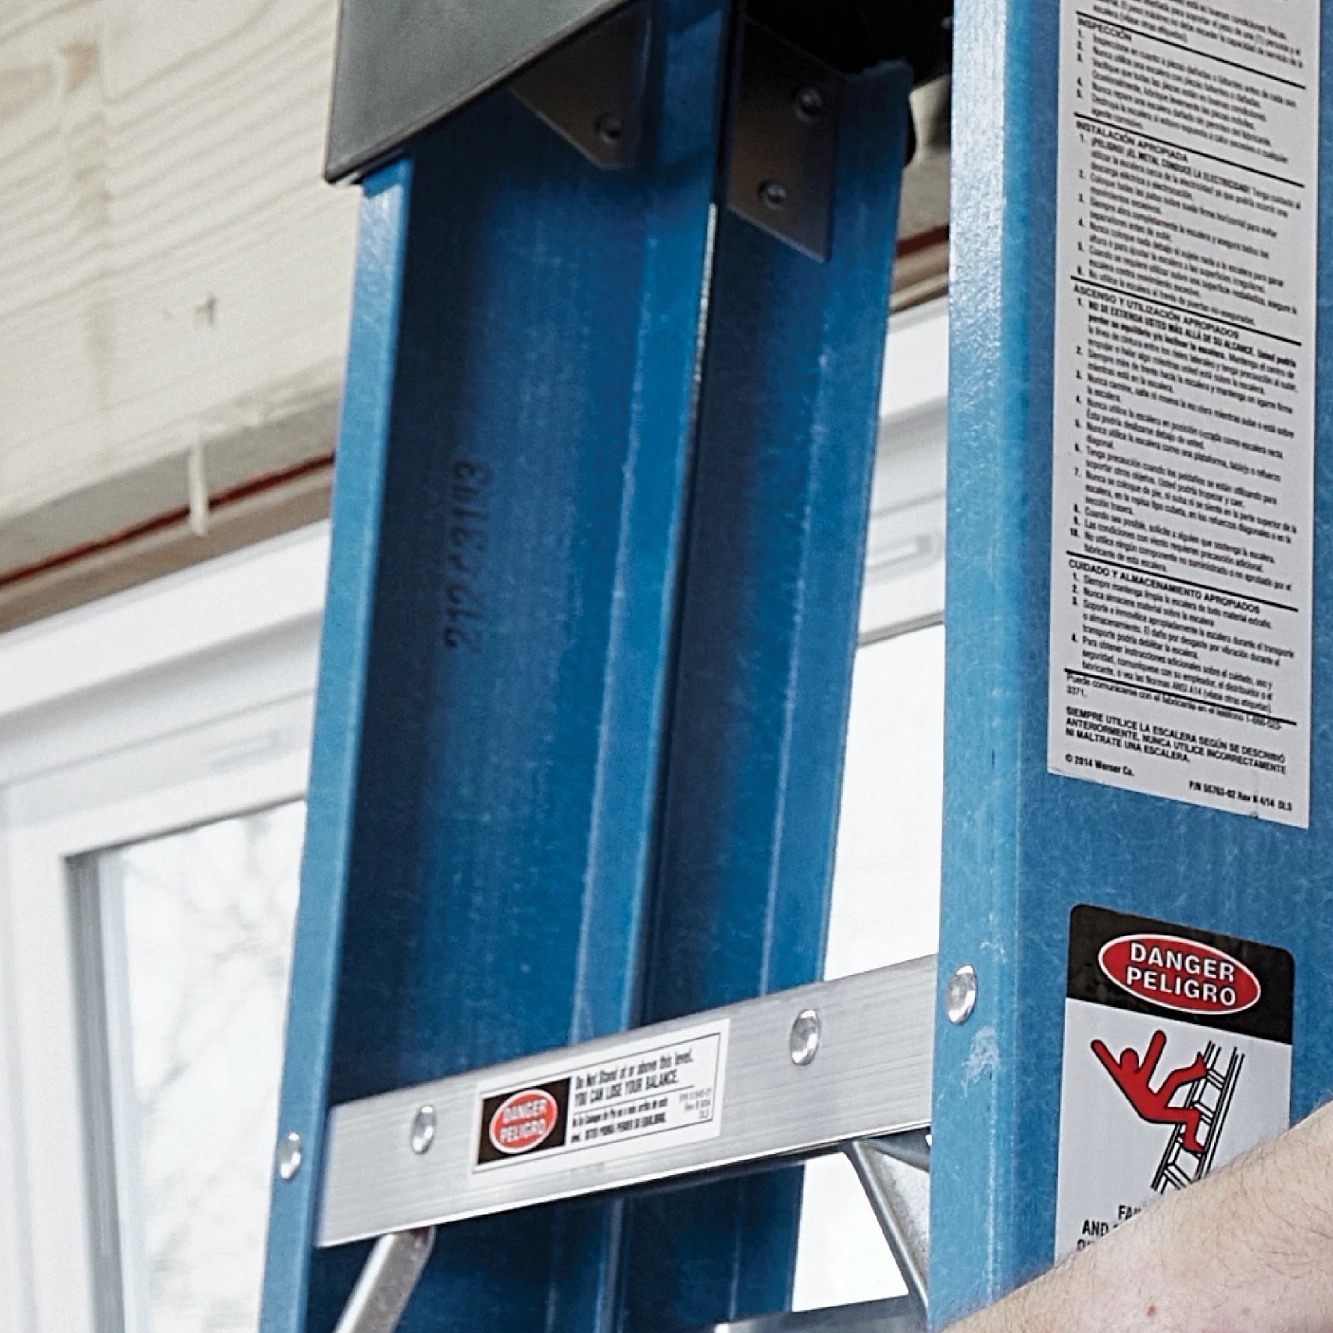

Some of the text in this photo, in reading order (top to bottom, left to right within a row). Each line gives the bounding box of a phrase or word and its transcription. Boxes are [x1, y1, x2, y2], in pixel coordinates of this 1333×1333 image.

[1076, 120, 1187, 162] INSTALACIÓN APROPIADA
[1074, 282, 1238, 339] ASCENSO Y UTILIZACIÓN APROPIADOS
[1068, 558, 1259, 614] CUIDADO Y ALMACENAMIENTO APROPIADOS
[1065, 726, 1074, 737] NI
[1076, 728, 1121, 748] MALTRATE
[1123, 739, 1141, 752] UNA
[1066, 705, 1285, 763] SIEMPRE UTILICE LA ESCALERA SEGÚN SE DESCRIBIÓ
[1142, 733, 1171, 748] NUNCA
[1173, 740, 1204, 756] UTILICE
[1206, 747, 1285, 774] INCORRECTAMENTE
[1130, 942, 1235, 983] DANGER
[1126, 966, 1236, 1007] PELIGRO
[501, 1096, 546, 1122] DANGER
[573, 1091, 588, 1108] YOU
[589, 1087, 603, 1104] CAN
[605, 1082, 622, 1101] LOSE
[623, 1077, 643, 1096] YOUR
[498, 1117, 545, 1145] PELIGRO
[1082, 1219, 1109, 1237] AND
